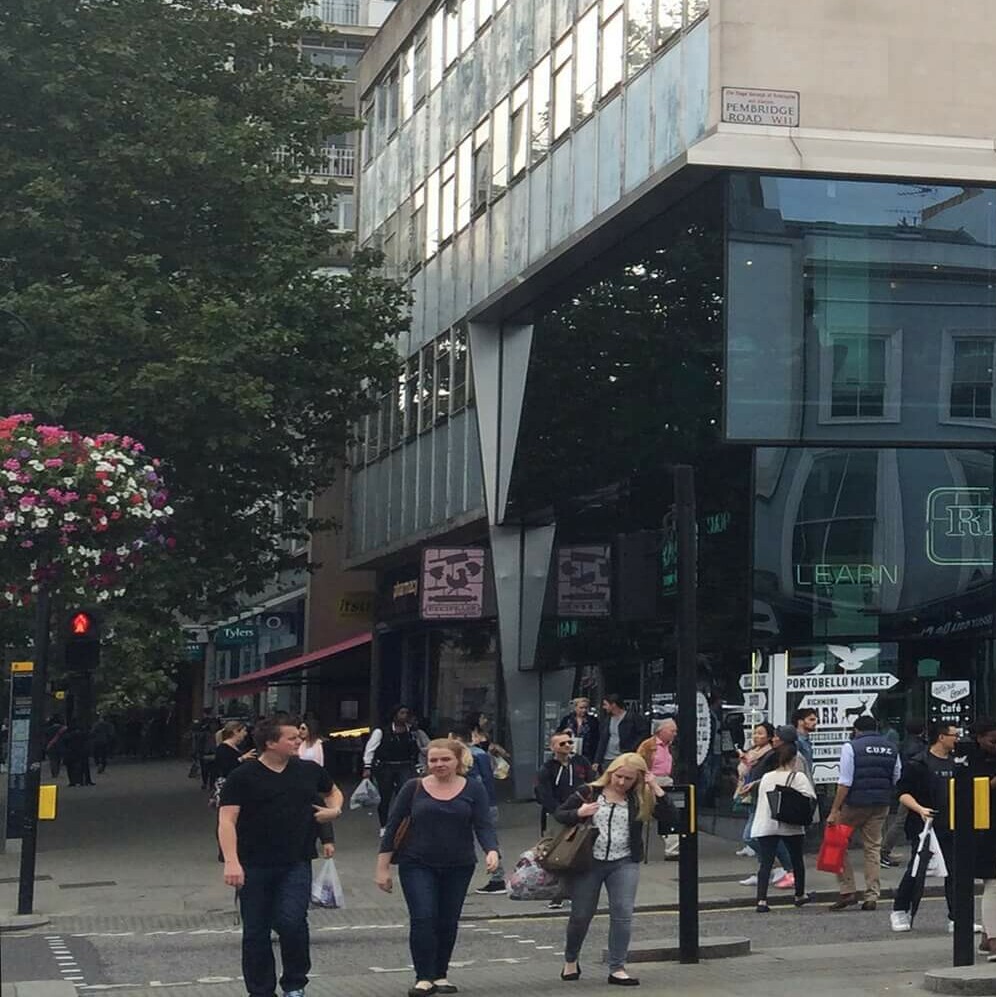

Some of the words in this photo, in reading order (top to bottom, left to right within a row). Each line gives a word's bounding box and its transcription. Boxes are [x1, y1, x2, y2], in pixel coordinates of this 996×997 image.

[726, 102, 795, 116] PEMBRIDGE
[728, 113, 762, 123] ROAD
[796, 564, 899, 586] LEARN
[224, 628, 254, 639] Tylers
[786, 677, 848, 689] PORTOBELLO
[850, 675, 891, 687] MARKET
[940, 702, 961, 713] Café
[815, 706, 839, 725] ARK
